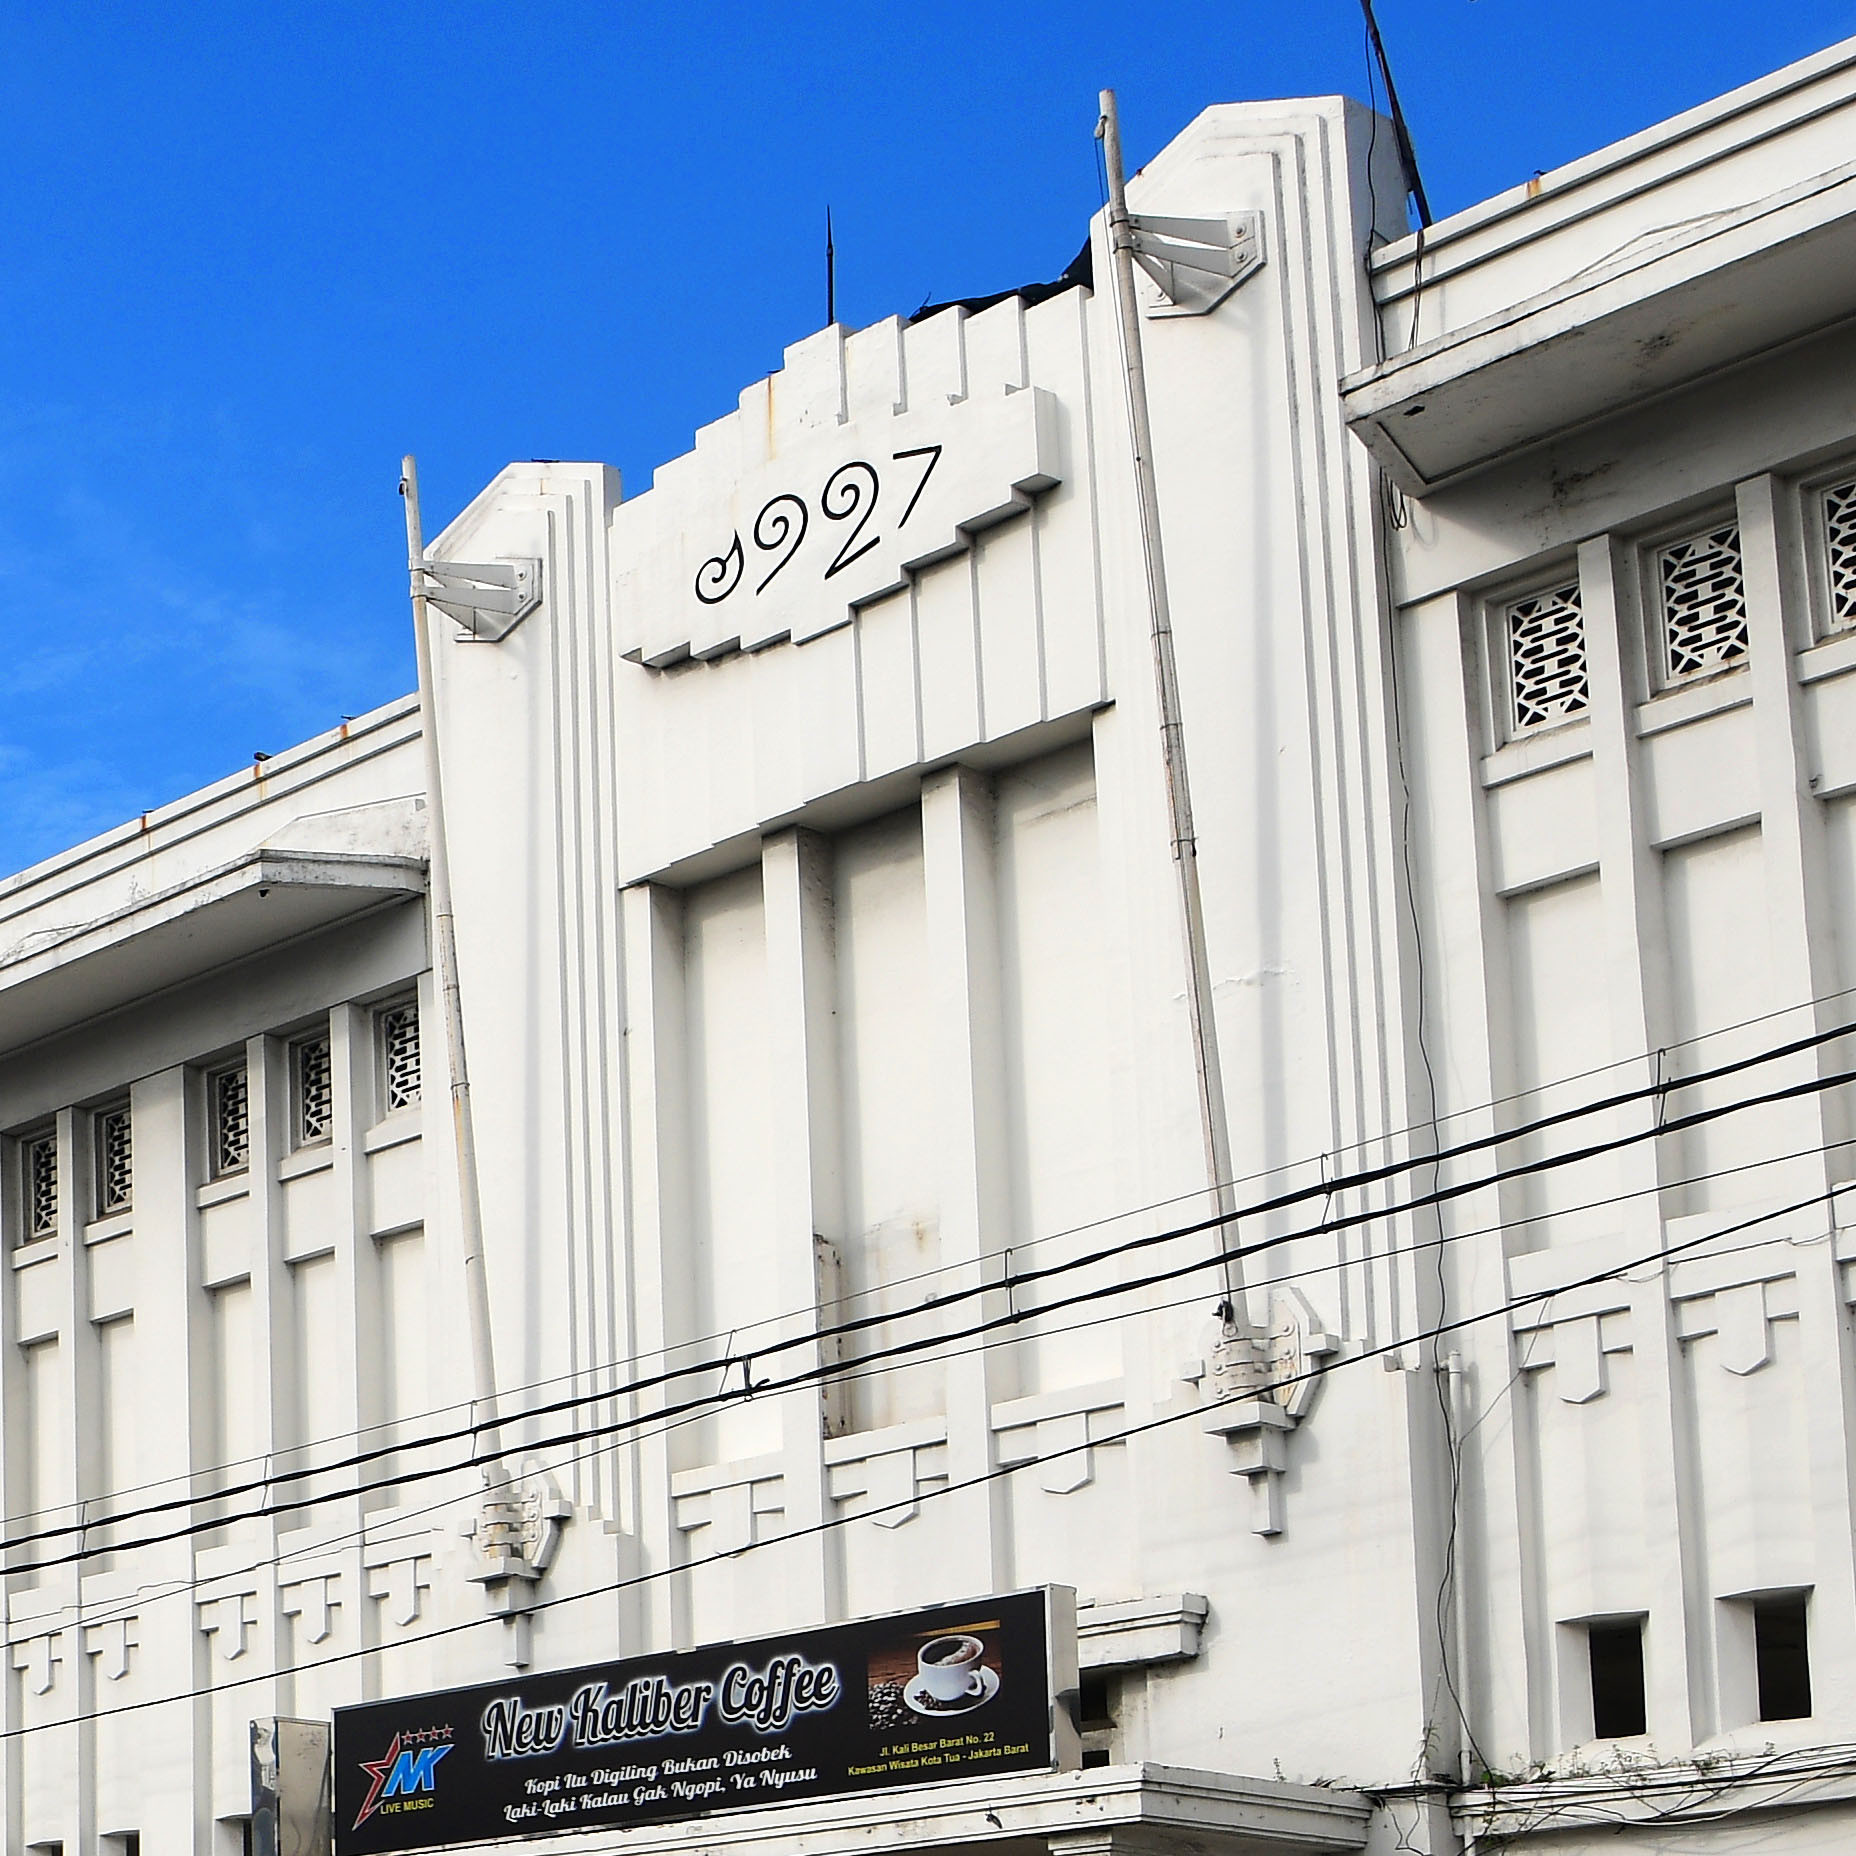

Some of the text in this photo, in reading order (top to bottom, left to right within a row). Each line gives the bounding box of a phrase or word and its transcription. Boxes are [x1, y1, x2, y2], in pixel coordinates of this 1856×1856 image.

[694, 444, 943, 605] 1927
[481, 1655, 839, 1759] New Kaliber Coffee
[847, 1763, 887, 1776] Kawasan
[889, 1759, 919, 1771] Wisata
[921, 1756, 942, 1767] Kota
[944, 1753, 960, 1763] Tua
[968, 1748, 1001, 1760] Jakarta
[1004, 1744, 1029, 1755] Barat
[892, 1744, 909, 1754] Kali
[911, 1741, 937, 1753] Besar
[939, 1738, 964, 1749] Barat
[966, 1735, 981, 1745] No.
[983, 1731, 995, 1742] 22
[525, 1774, 561, 1794] Kopi
[591, 1763, 657, 1787] Digiling
[661, 1754, 719, 1775] Bukan
[723, 1744, 792, 1767] Disobek
[380, 1798, 435, 1814] LIVE MUSIC
[503, 1799, 576, 1822] Laki-Laki
[579, 1792, 629, 1811] Kalau
[633, 1785, 668, 1806] Gak
[730, 1770, 757, 1790] Ya
[759, 1767, 818, 1789] Nyusu
